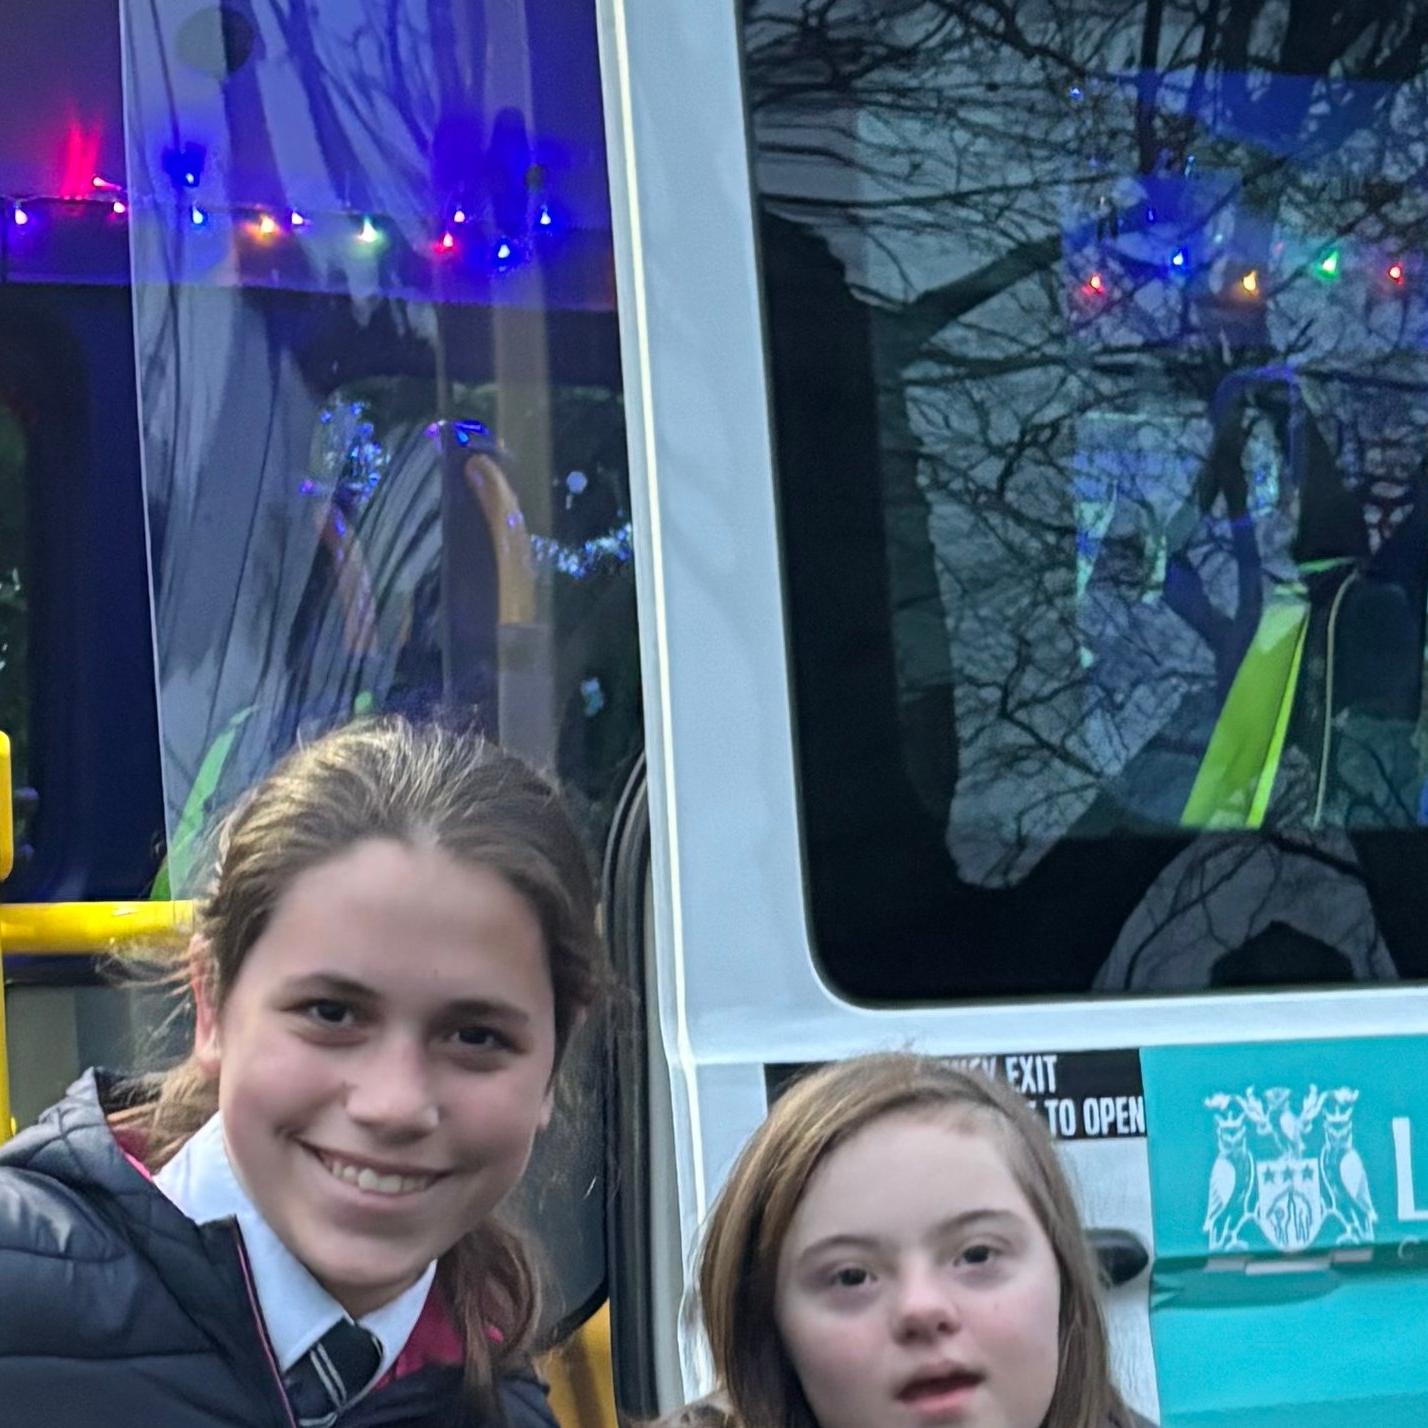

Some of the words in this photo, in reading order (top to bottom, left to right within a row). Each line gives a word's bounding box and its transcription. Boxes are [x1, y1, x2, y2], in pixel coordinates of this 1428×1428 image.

[1004, 1055, 1057, 1094] EXIT
[1044, 1098, 1077, 1137] TO
[1083, 1095, 1146, 1136] OPEN
